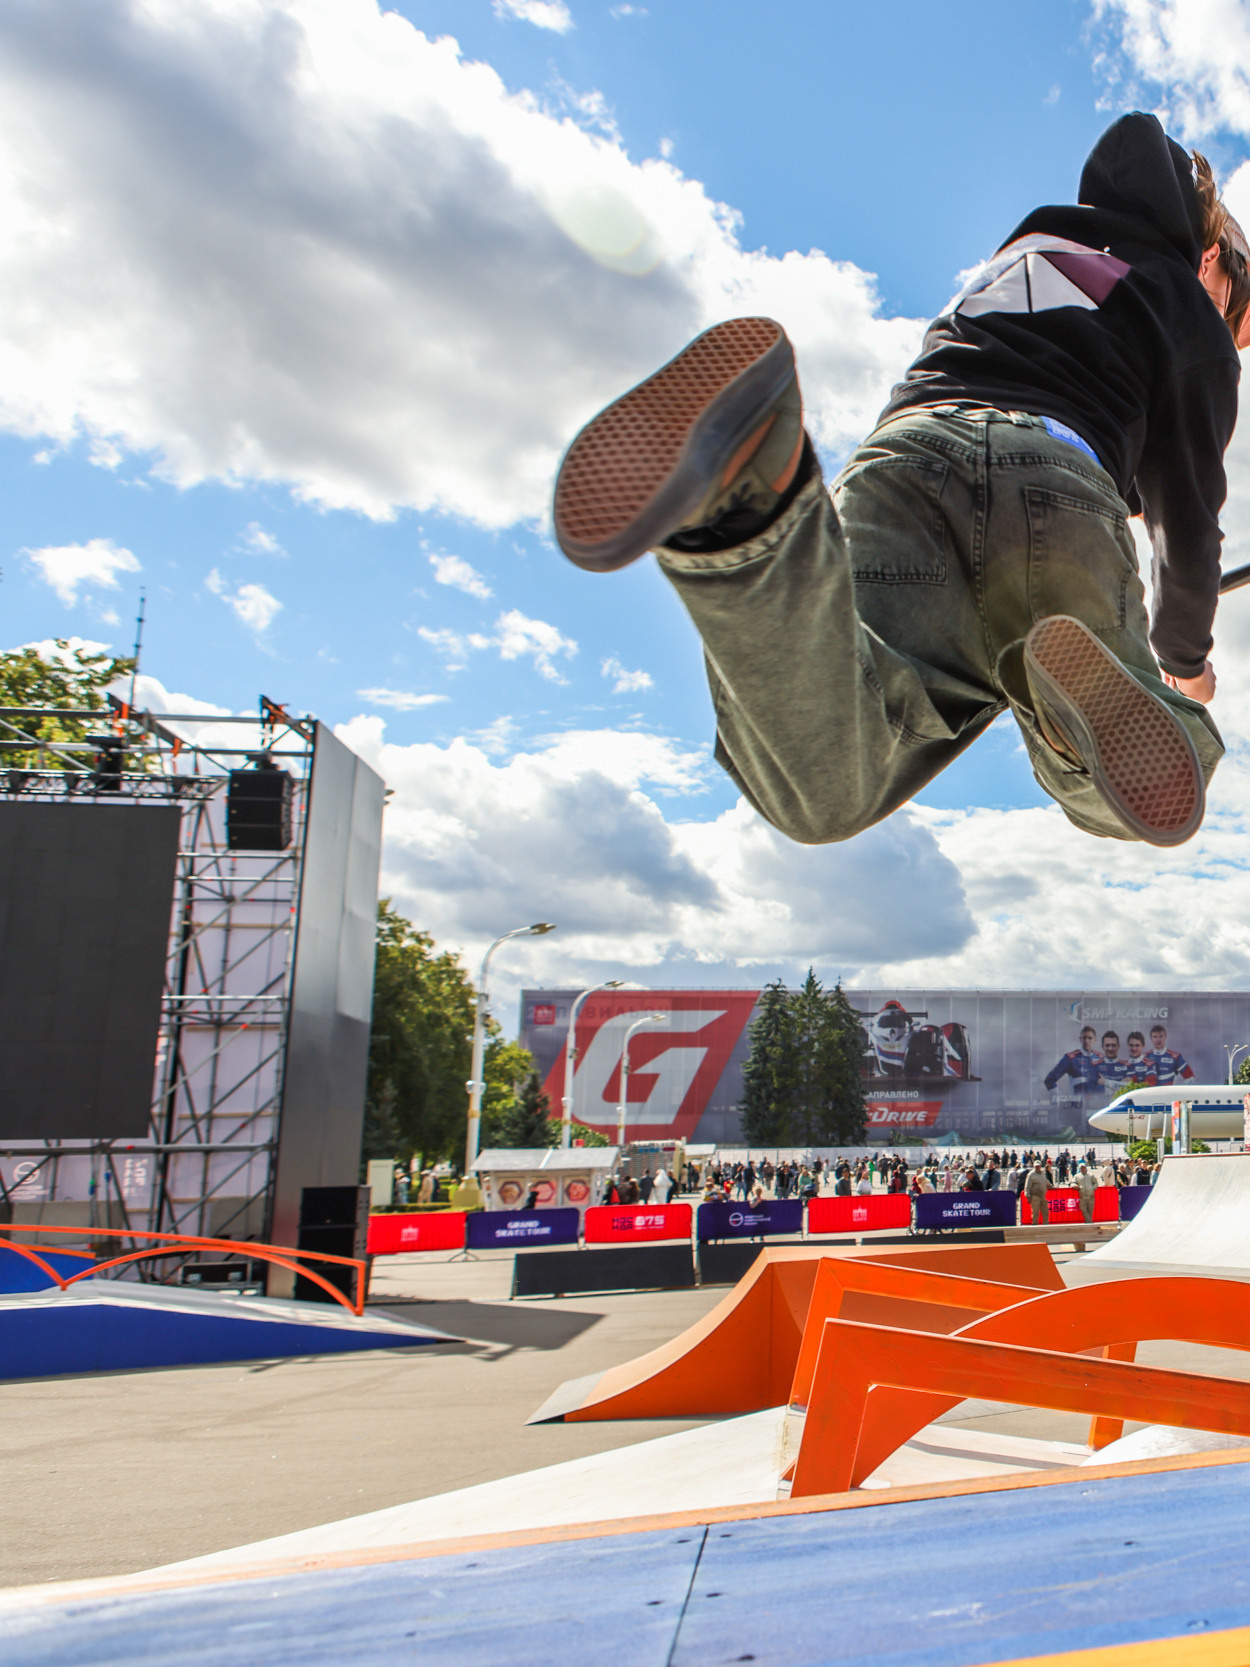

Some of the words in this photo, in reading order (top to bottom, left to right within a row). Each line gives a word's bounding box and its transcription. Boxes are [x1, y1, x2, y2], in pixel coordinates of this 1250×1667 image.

[1116, 1007, 1169, 1019] RACING
[863, 1090, 919, 1099] АПРАВЛЕНО
[953, 1202, 980, 1210] GRAND
[495, 1228, 526, 1238] SKATE
